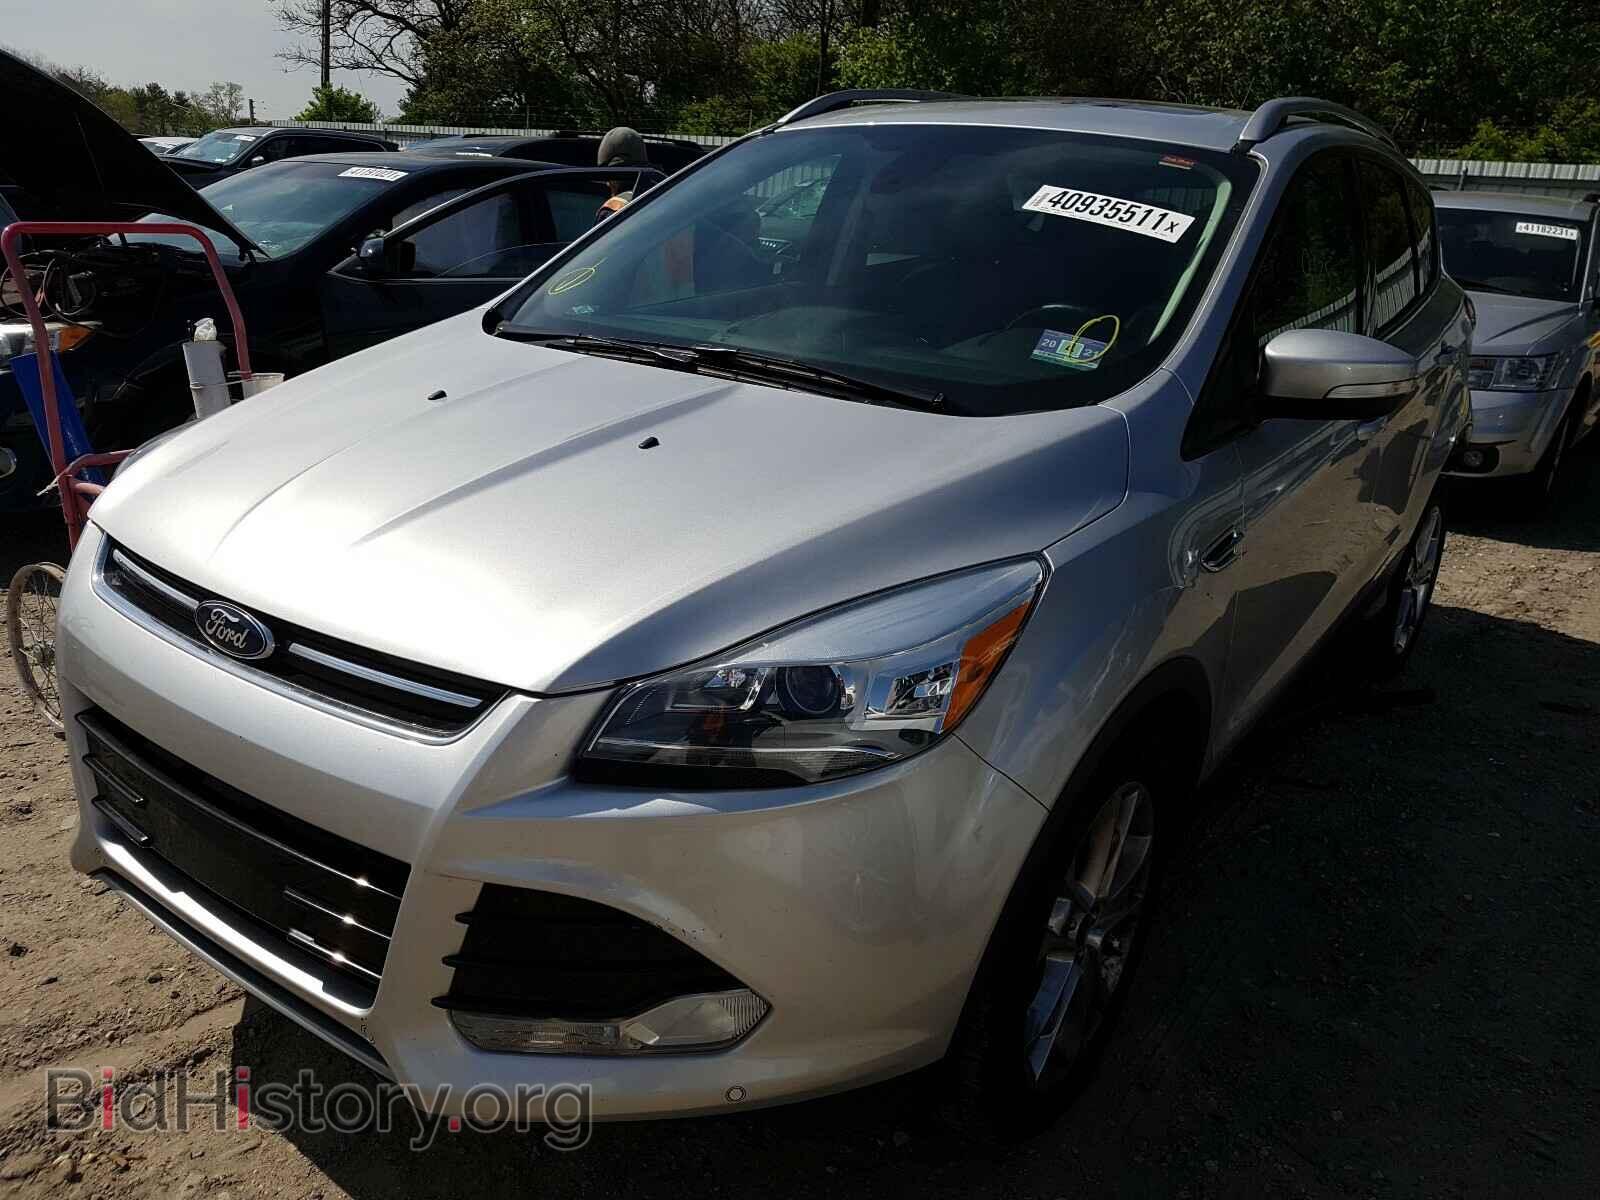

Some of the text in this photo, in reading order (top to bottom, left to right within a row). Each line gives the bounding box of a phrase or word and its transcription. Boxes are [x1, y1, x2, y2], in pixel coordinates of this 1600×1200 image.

[1048, 190, 1169, 231] 40935511
[1041, 338, 1057, 348] 20
[205, 608, 250, 649] Ford
